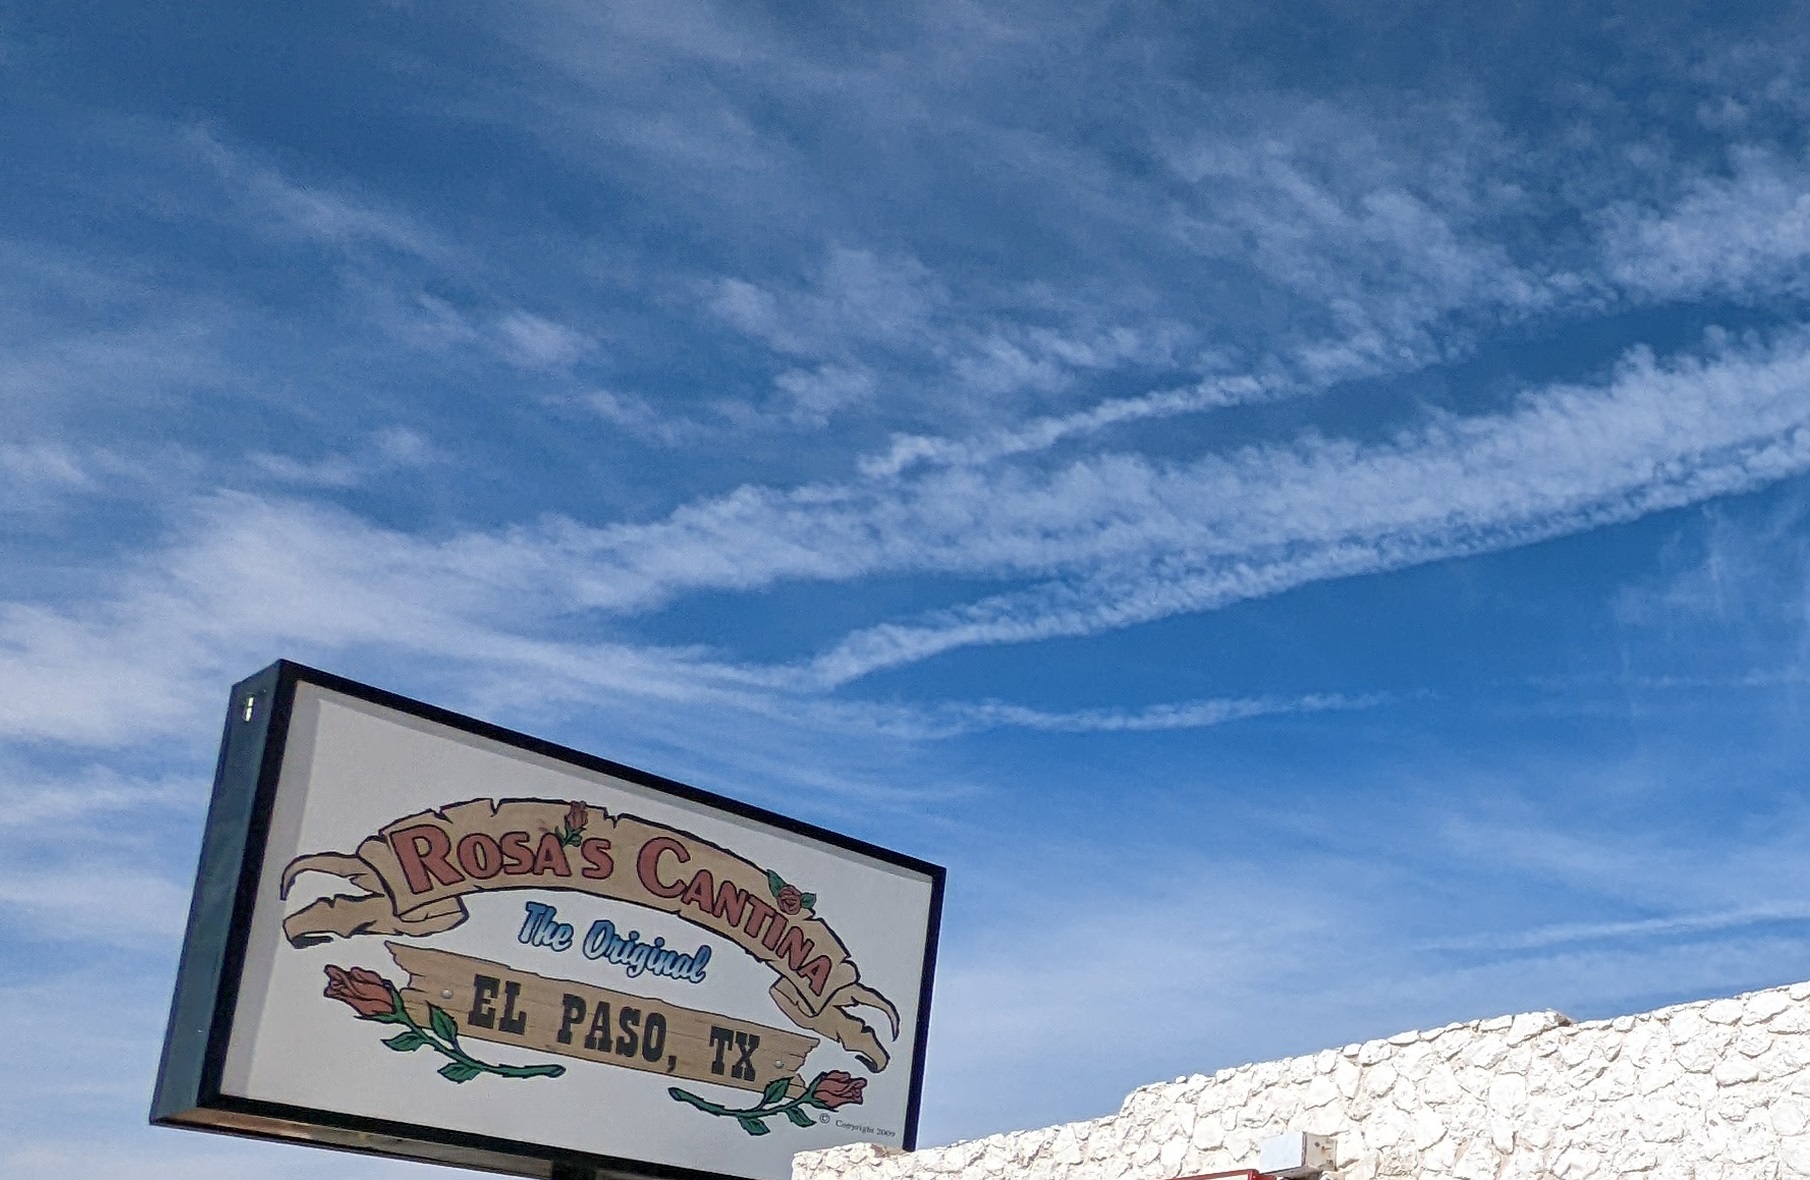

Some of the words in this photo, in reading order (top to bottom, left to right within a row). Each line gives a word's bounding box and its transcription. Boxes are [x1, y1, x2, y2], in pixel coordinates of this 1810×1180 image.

[390, 823, 614, 894] ROSA'S
[637, 836, 834, 997] CANTINA
[518, 901, 575, 952] The
[583, 919, 713, 984] Original
[468, 974, 527, 1035] EL
[557, 993, 680, 1072] PASO,
[708, 1025, 761, 1083] TX
[835, 1119, 875, 1134] Copyright
[876, 1127, 896, 1138] 2009
